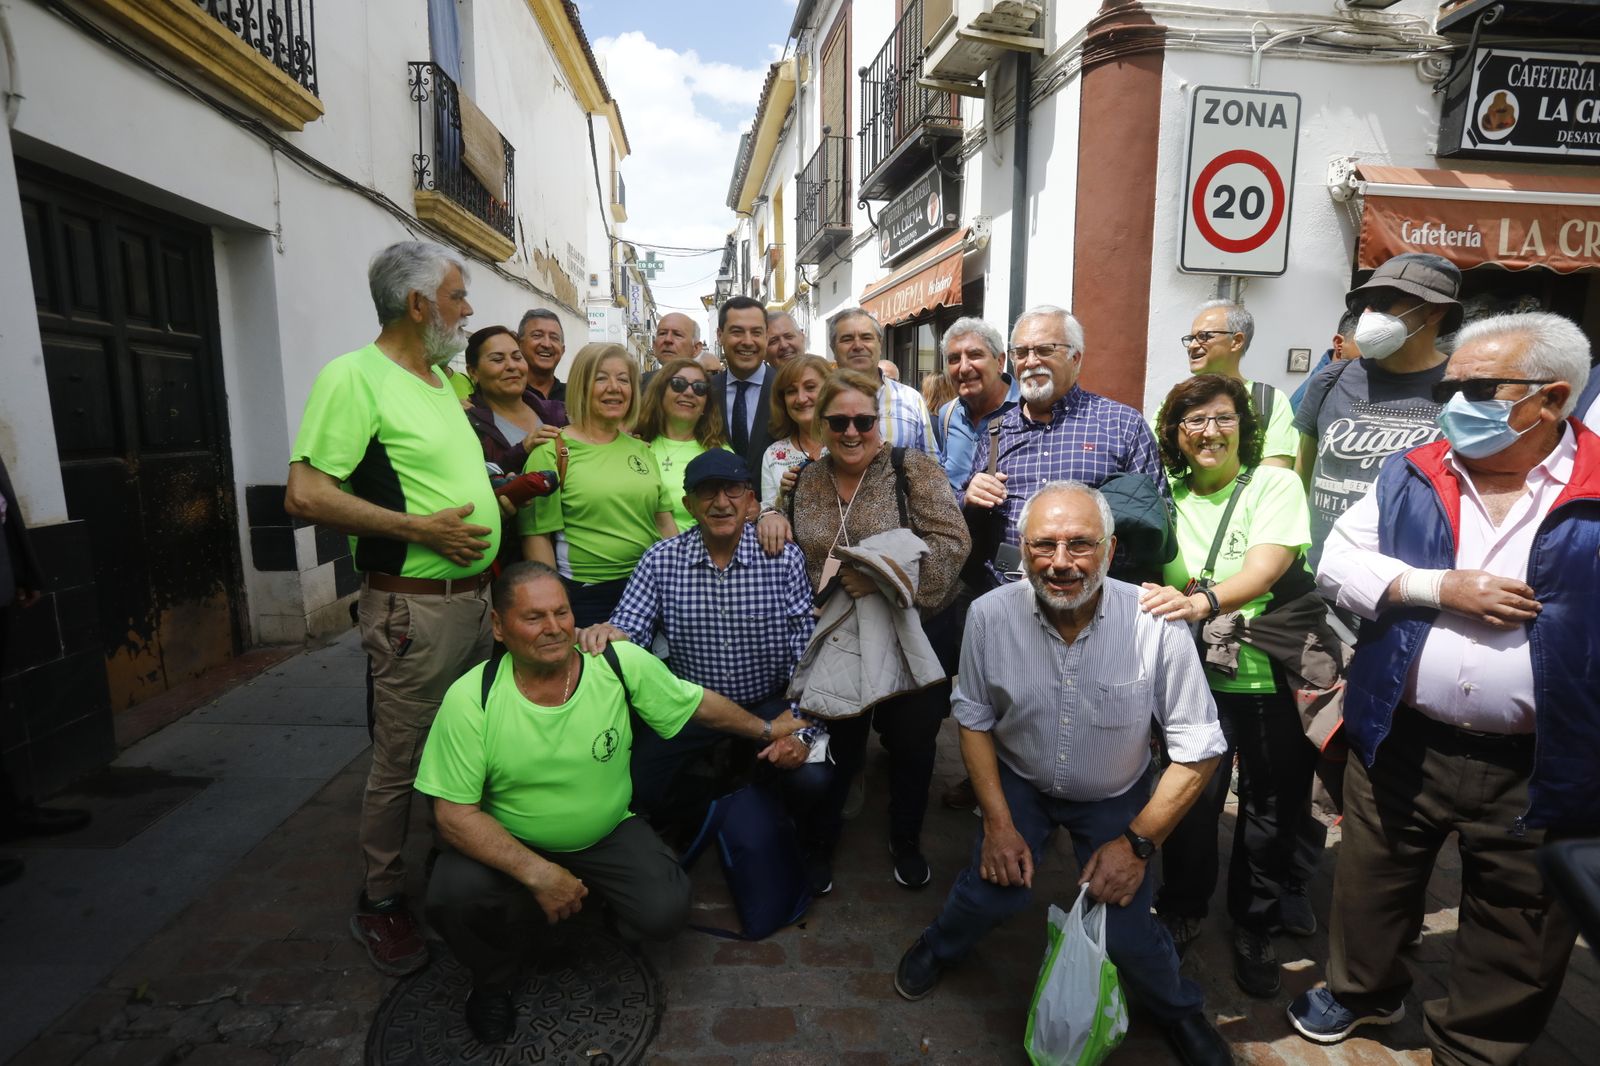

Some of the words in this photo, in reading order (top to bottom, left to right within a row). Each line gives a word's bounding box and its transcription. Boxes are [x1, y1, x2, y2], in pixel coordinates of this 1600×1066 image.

[1508, 64, 1595, 91] CAFETERIA
[1203, 98, 1288, 129] ZONA
[1538, 97, 1568, 122] LA
[1212, 184, 1265, 220] 20
[893, 225, 901, 239] LA
[901, 205, 923, 233] CREMA
[1401, 220, 1482, 248] Cafetería
[1498, 217, 1546, 257] LA
[631, 286, 640, 324] BOTICA
[880, 297, 891, 321] LA
[893, 281, 924, 315] CREMA
[1314, 491, 1358, 512] VINTA
